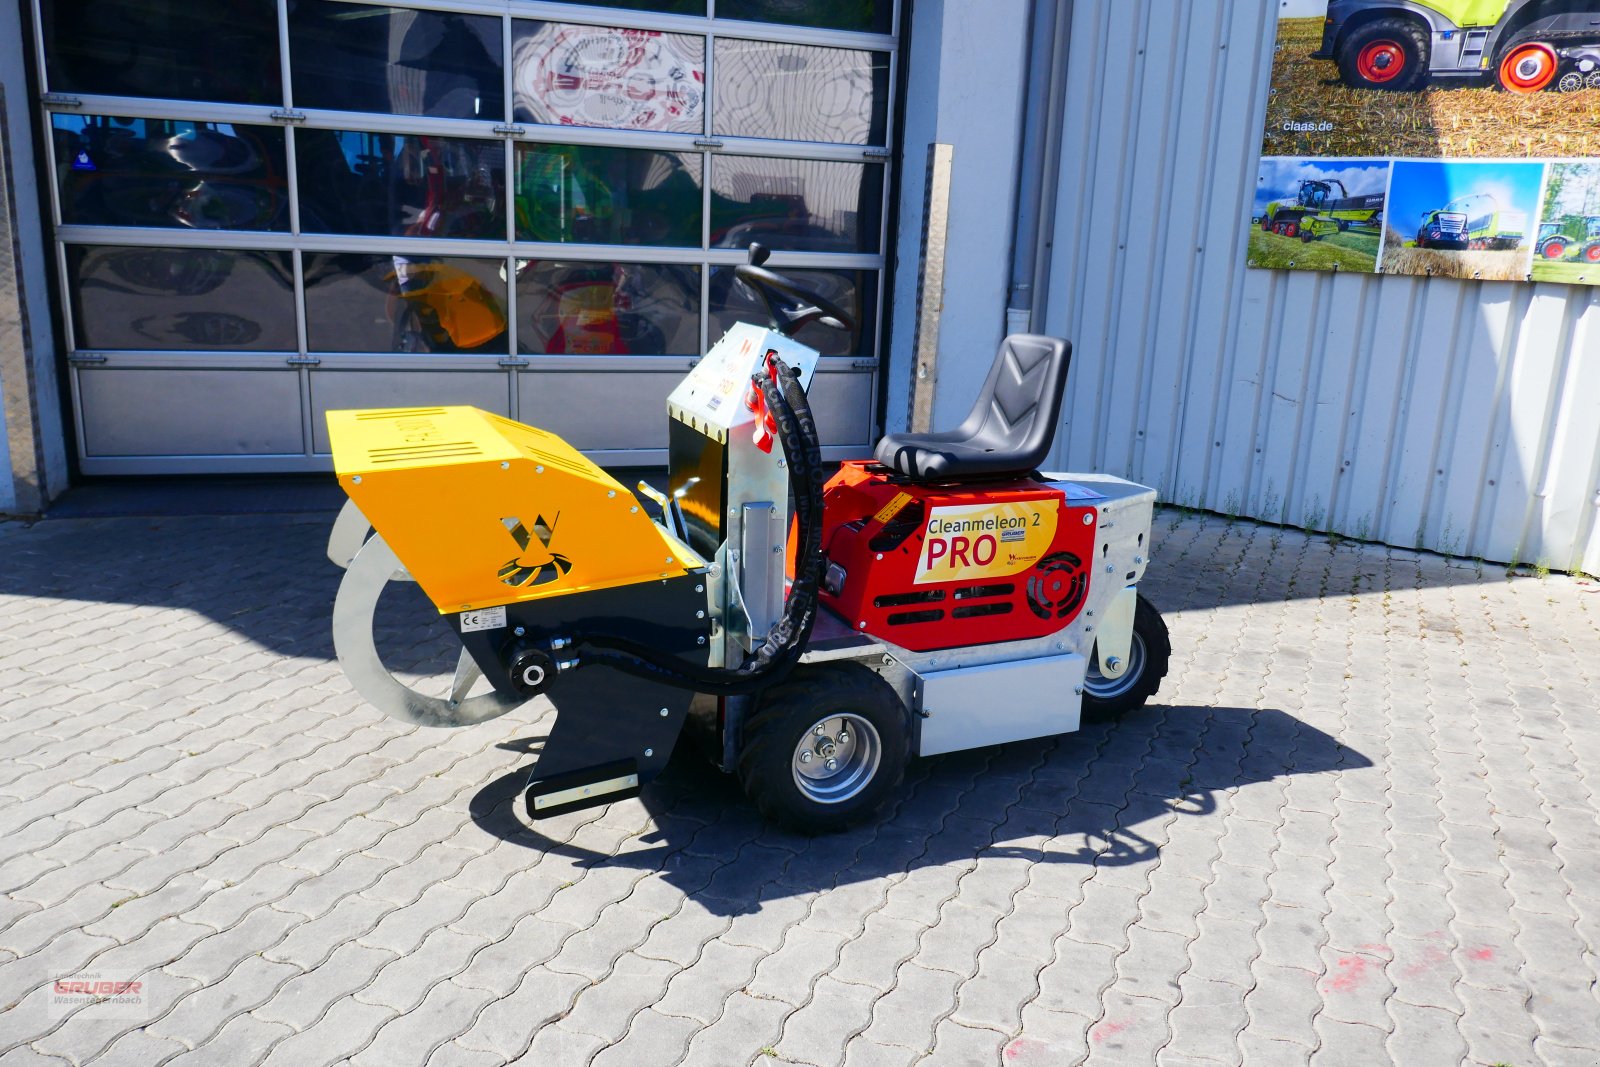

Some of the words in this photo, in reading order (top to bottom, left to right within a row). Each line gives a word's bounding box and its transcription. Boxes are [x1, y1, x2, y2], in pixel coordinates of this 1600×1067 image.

[1283, 120, 1333, 131] claas.de
[928, 515, 1027, 534] Cleanmeleon
[1031, 512, 1041, 527] 2
[926, 534, 997, 571] PRO
